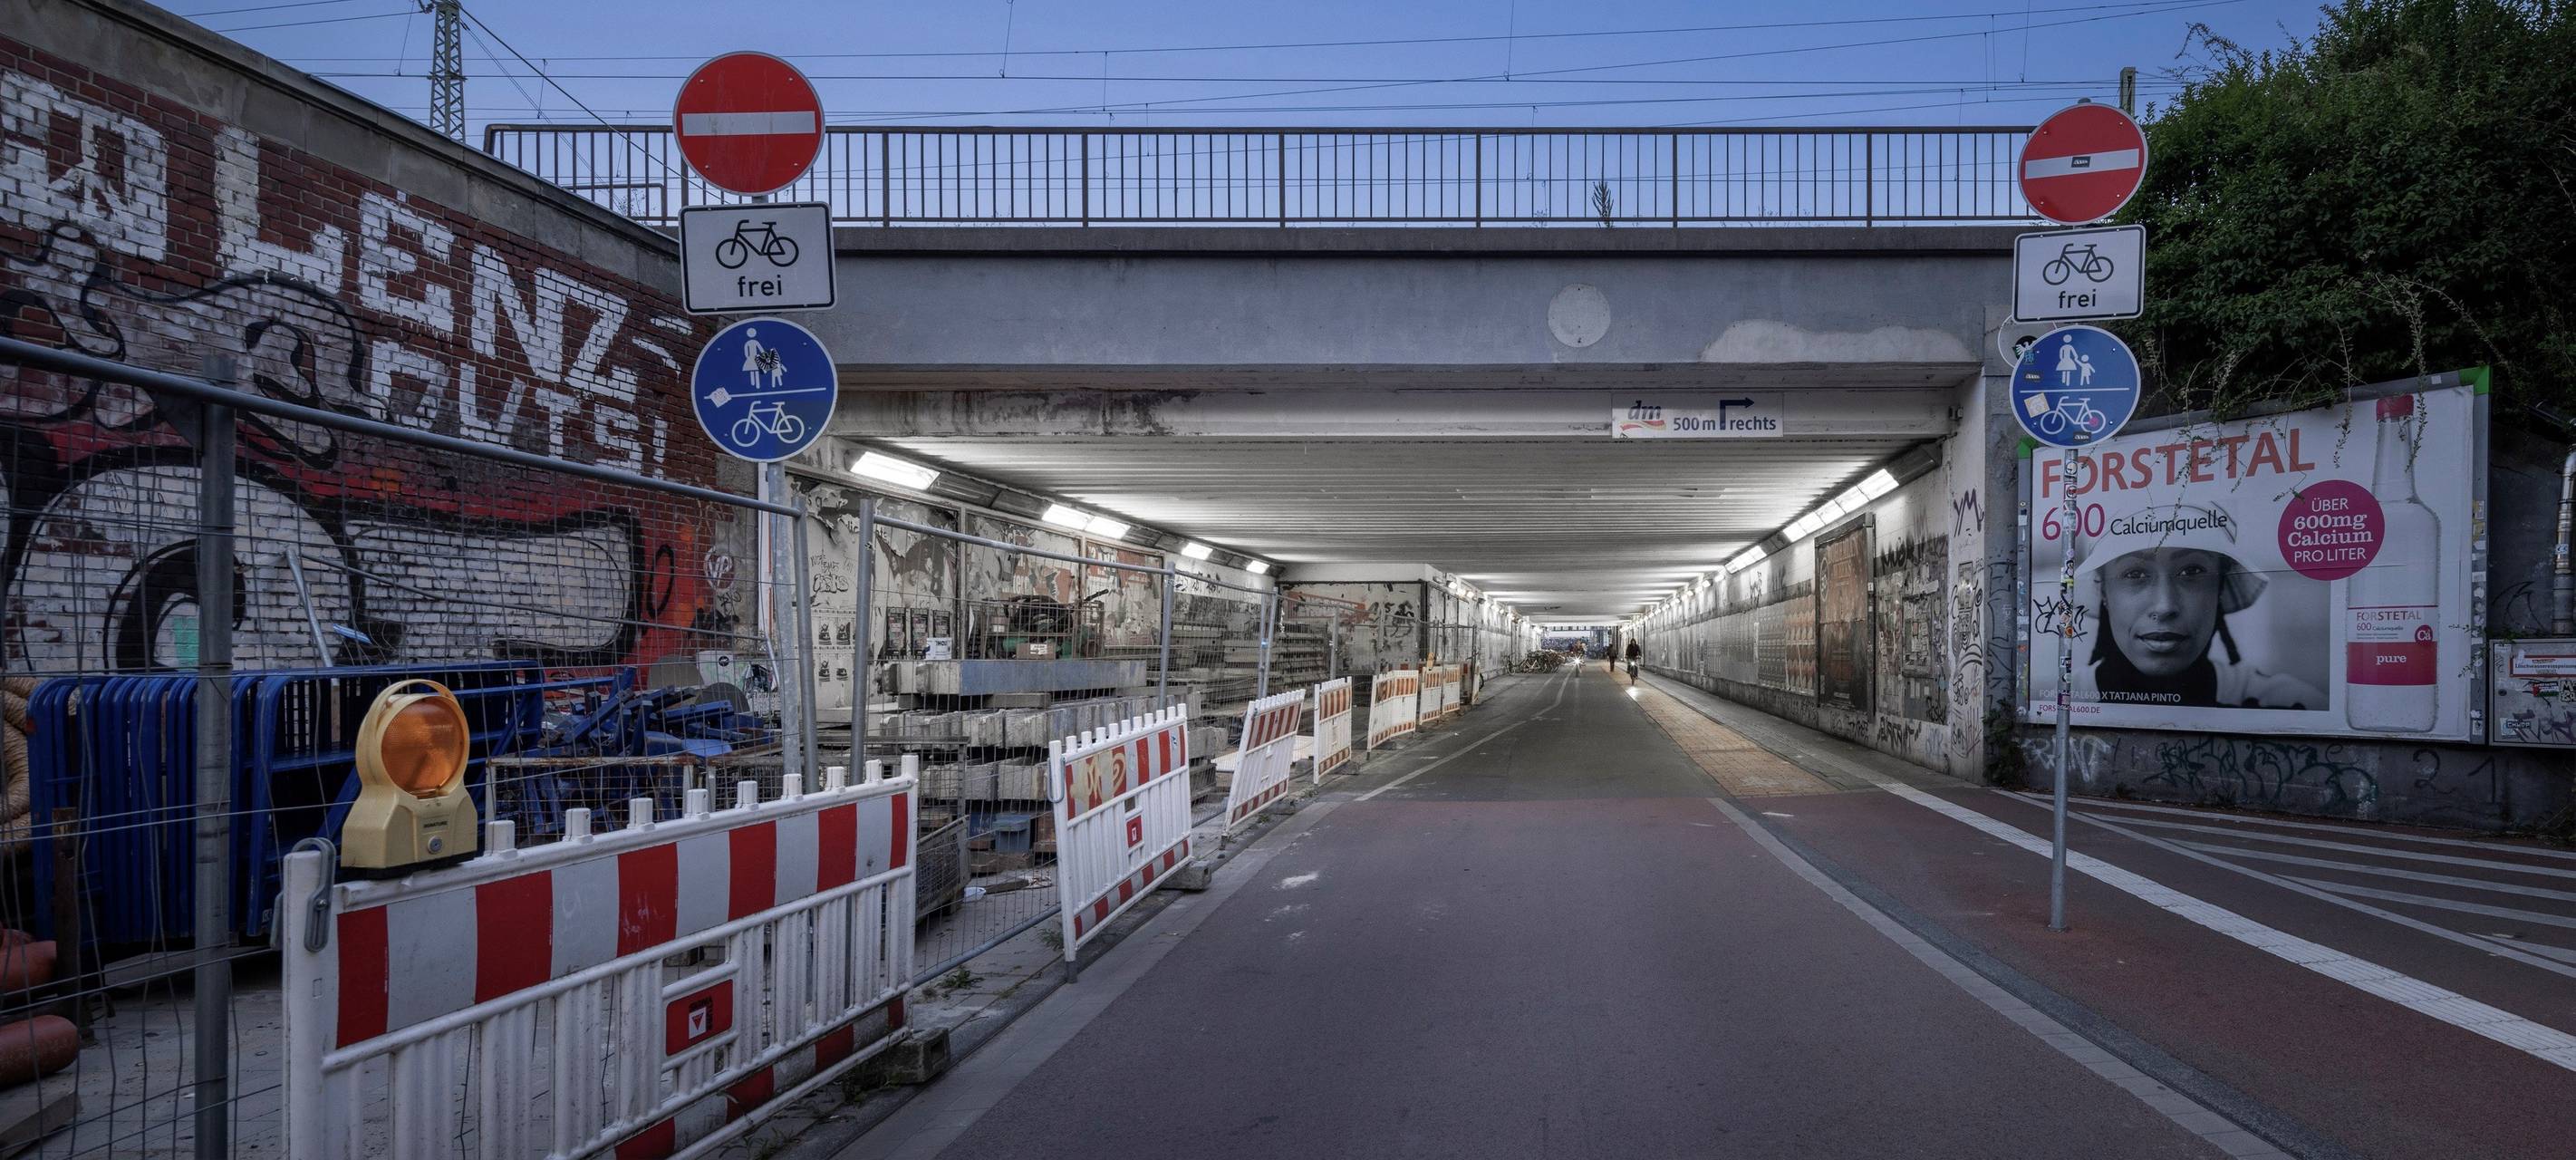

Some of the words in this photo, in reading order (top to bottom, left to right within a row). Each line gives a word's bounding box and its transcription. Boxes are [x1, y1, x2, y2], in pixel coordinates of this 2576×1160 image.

[738, 275, 783, 299] frei
[2059, 289, 2098, 309] frei
[1627, 400, 1663, 420] dm
[1674, 418, 1700, 431] 500
[1703, 419, 1716, 430] m
[1730, 416, 1777, 430] rechts
[2041, 428, 2315, 498] FORSTETAL
[2311, 498, 2349, 512] ÜBER
[2110, 509, 2228, 536] Calciumquelle
[2293, 514, 2368, 530] 600mg
[2287, 529, 2374, 547] Calcium
[2294, 549, 2324, 563] PRO
[2327, 547, 2367, 561] LITER
[2357, 610, 2422, 622] FORSTETAL
[2356, 622, 2371, 632] 600
[2376, 654, 2407, 665] pure
[2101, 691, 2108, 700] X
[2109, 691, 2151, 701] TATJANA
[2151, 692, 2182, 702] PINTO
[2039, 704, 2101, 714] FORSAL600.DE
